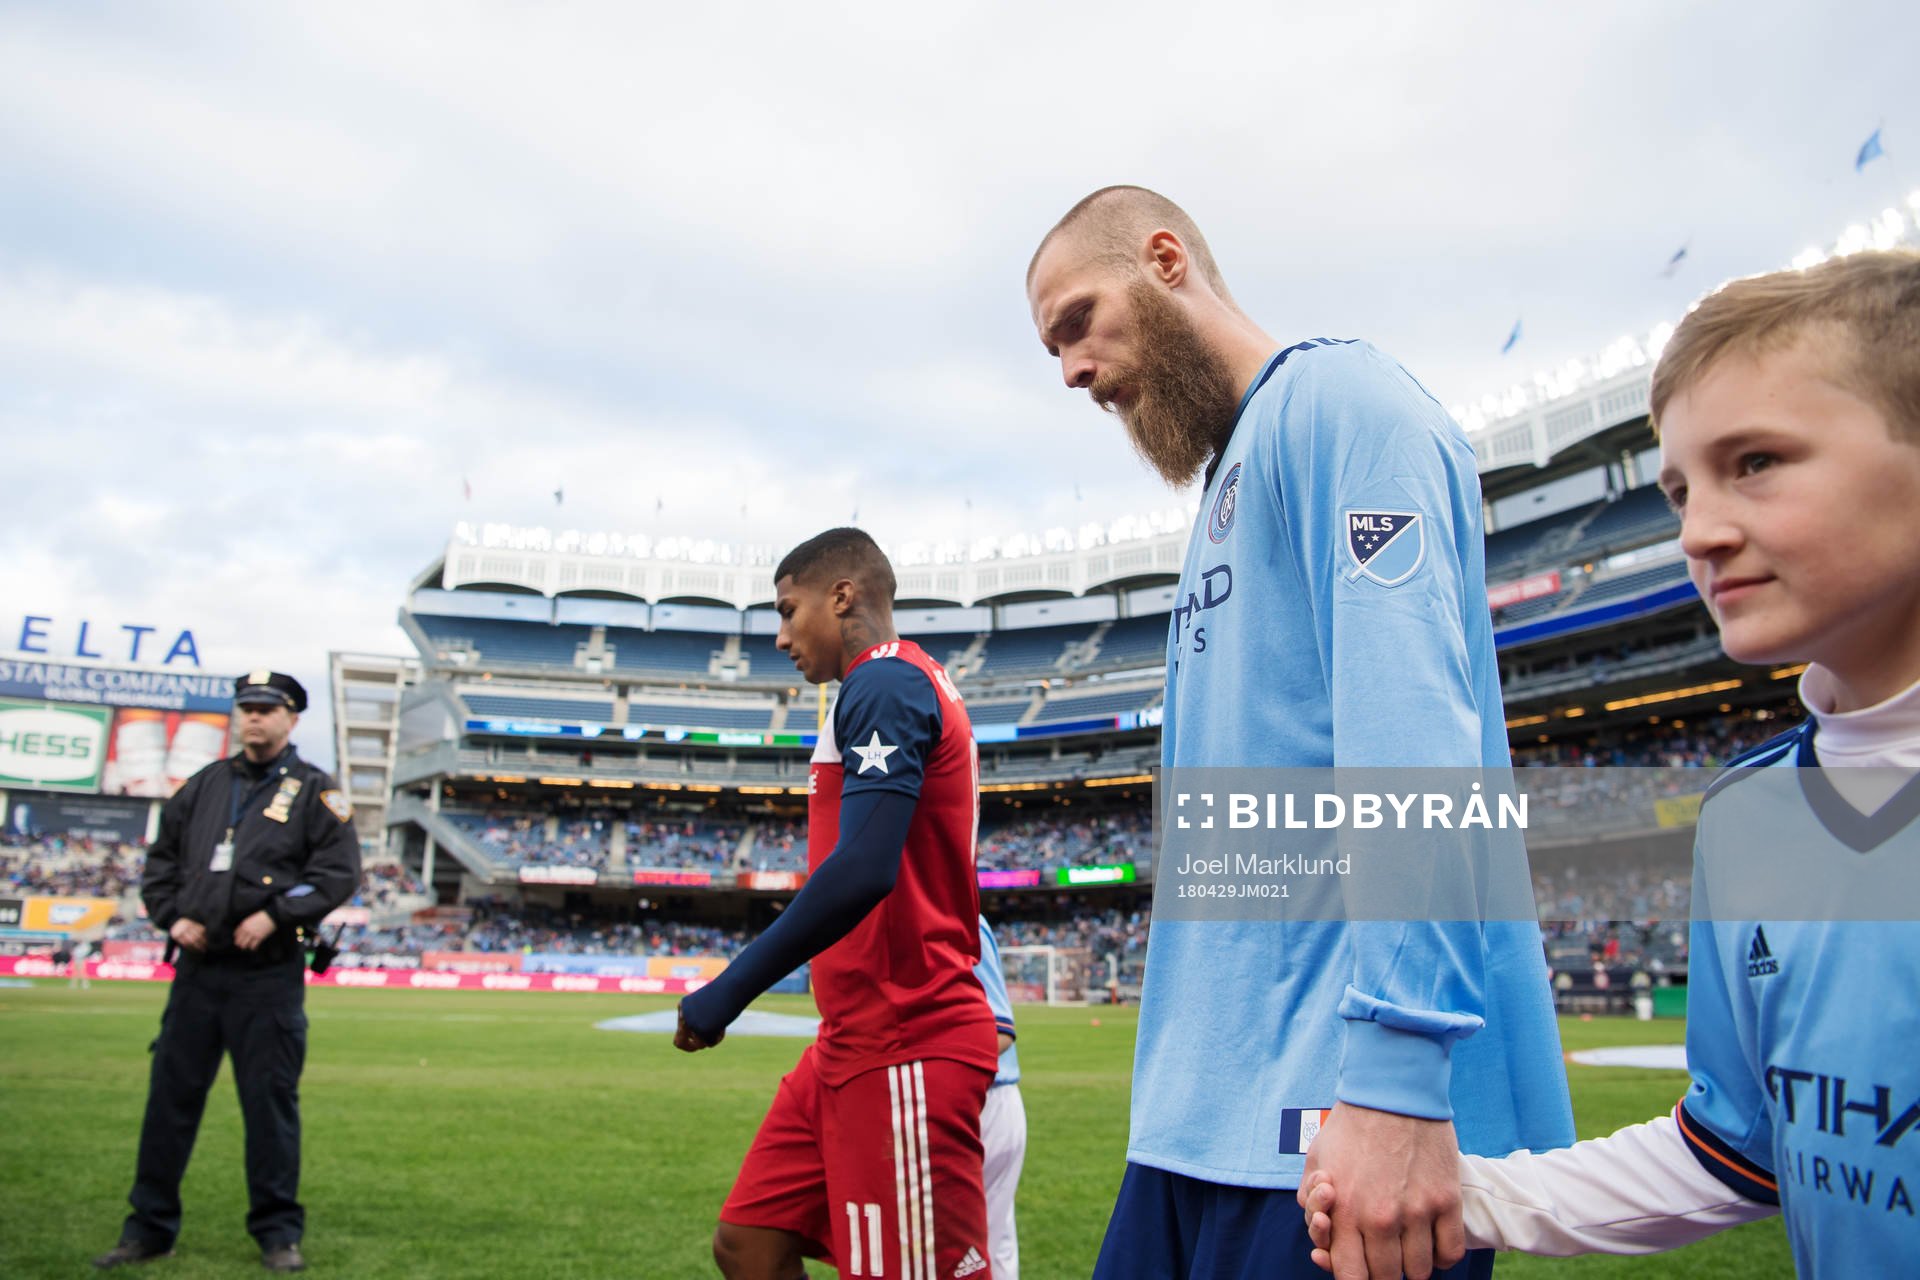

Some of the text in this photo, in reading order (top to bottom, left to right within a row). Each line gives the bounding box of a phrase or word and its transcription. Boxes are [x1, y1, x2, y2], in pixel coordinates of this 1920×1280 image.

[1352, 516, 1394, 532] MLS
[18, 615, 201, 668] ELTA
[86, 670, 236, 699] COMPANIES
[867, 751, 881, 760] LH
[846, 1201, 884, 1278] 11
